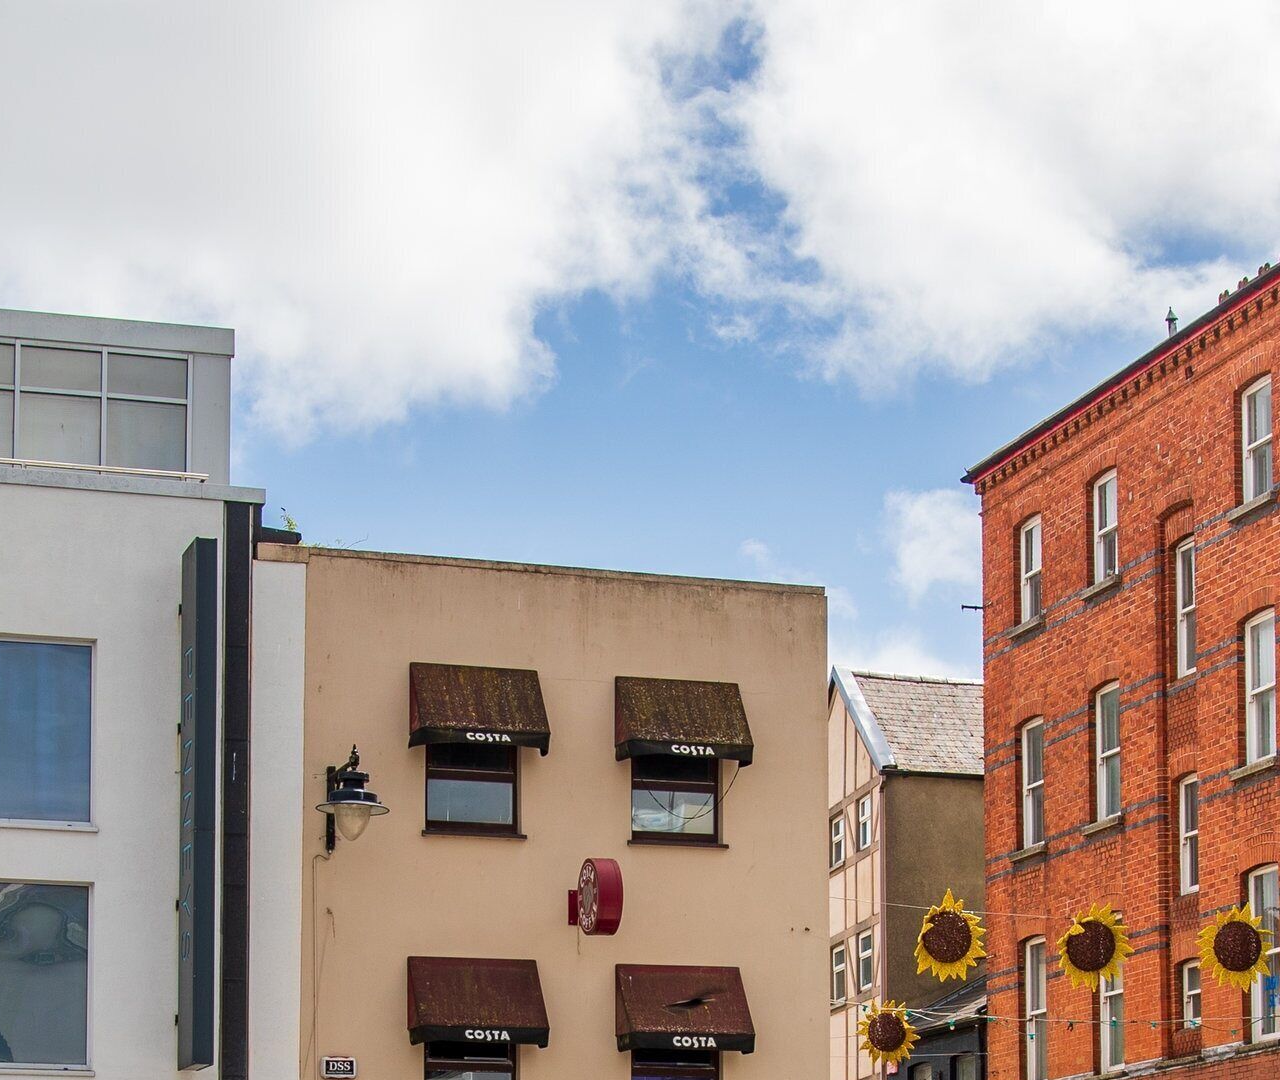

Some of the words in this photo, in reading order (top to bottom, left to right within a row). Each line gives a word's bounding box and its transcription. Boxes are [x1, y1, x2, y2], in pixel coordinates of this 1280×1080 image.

[466, 732, 511, 743] COSTA
[671, 744, 715, 756] COSTA
[465, 1029, 510, 1041] COSTA
[672, 1036, 717, 1048] COSTA
[329, 1061, 351, 1071] DSS
